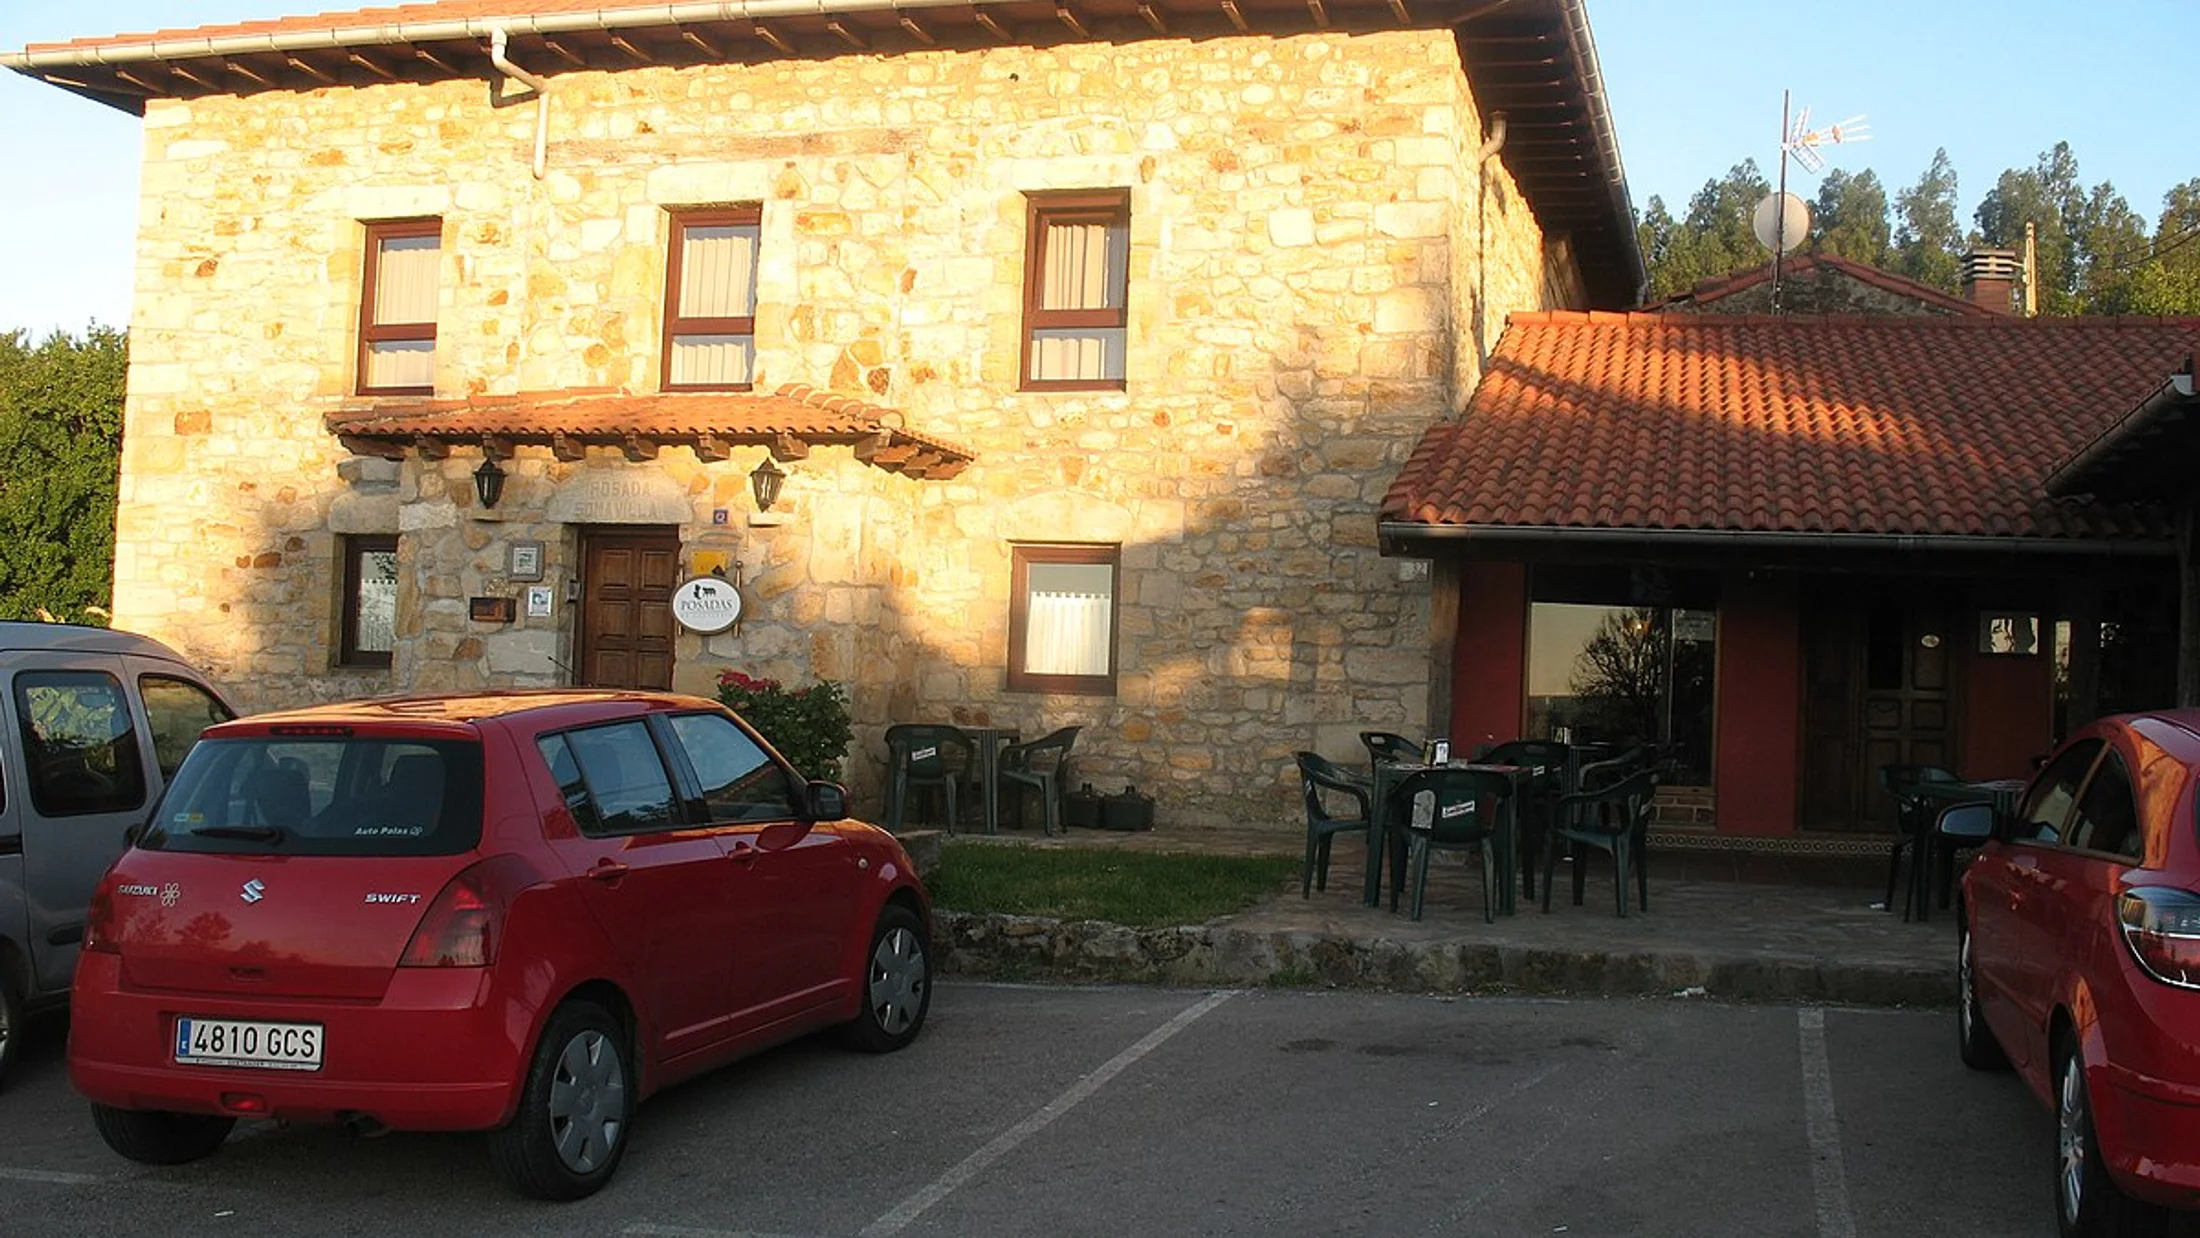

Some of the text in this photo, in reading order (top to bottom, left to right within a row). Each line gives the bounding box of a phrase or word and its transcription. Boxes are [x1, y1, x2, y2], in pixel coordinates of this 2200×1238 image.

[590, 481, 651, 497] POSADA
[681, 599, 733, 611] POSADAS
[354, 827, 379, 835] Auto
[117, 884, 158, 895] SUZUKI
[364, 893, 421, 904] SWIFT
[194, 1024, 258, 1055] 4810
[267, 1028, 315, 1058] GCS
